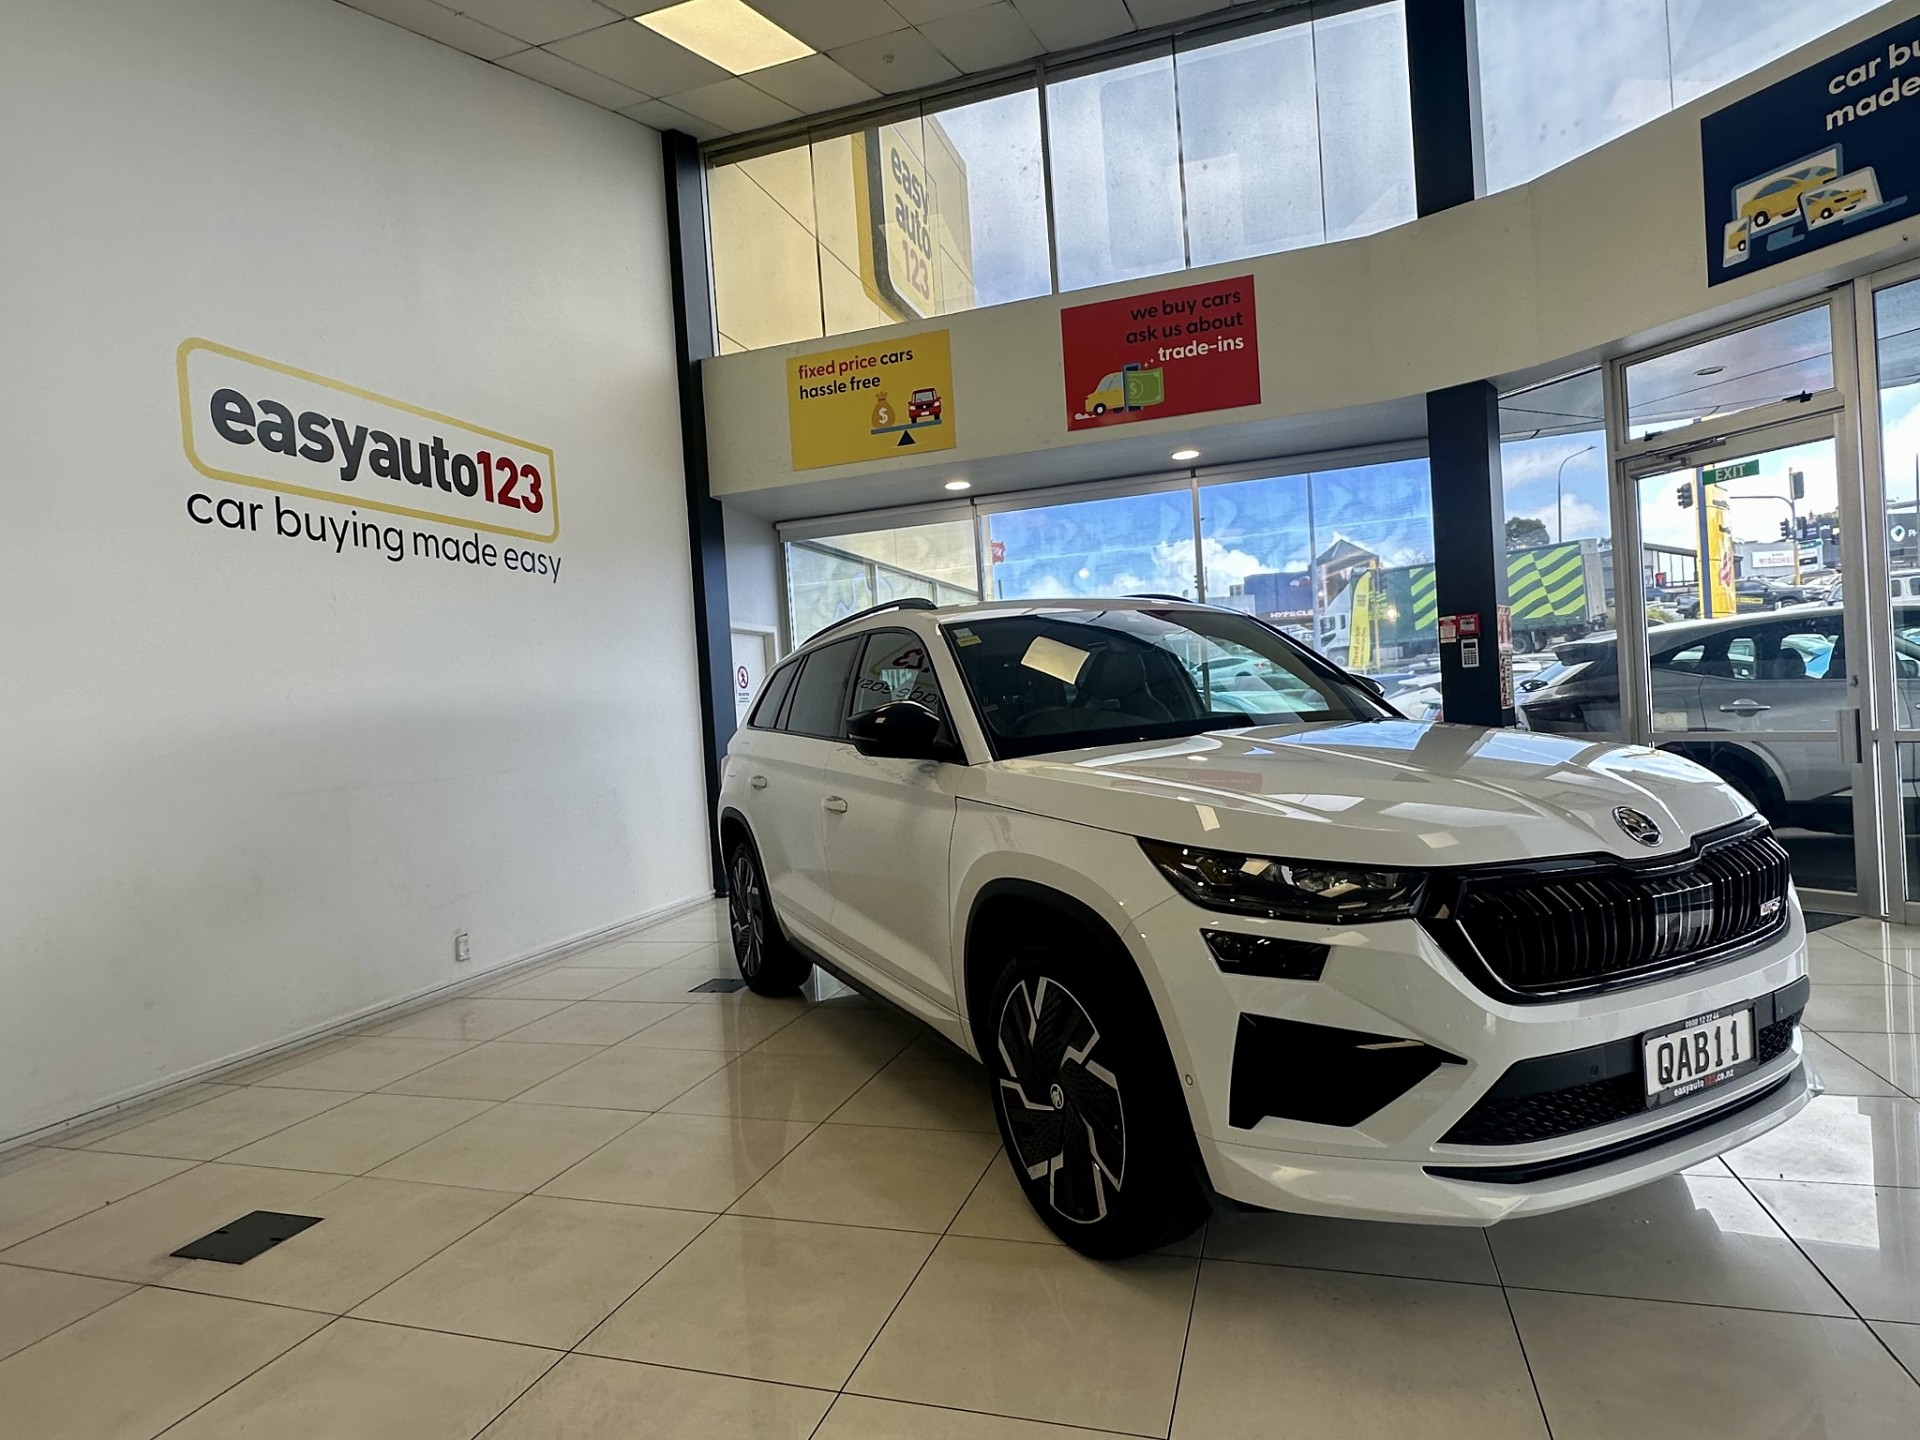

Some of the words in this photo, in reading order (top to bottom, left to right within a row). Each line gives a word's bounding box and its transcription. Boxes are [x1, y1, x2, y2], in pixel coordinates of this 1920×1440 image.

[1828, 57, 1881, 95] car
[1826, 76, 1920, 131] made
[890, 147, 929, 225] easy
[894, 193, 932, 261] auto
[902, 239, 930, 300] 123
[1126, 325, 1158, 344] ask
[1162, 323, 1182, 338] us
[1186, 312, 1243, 333] about
[1131, 305, 1158, 321] we
[1162, 299, 1197, 316] buy
[1201, 290, 1241, 309] cars
[798, 360, 836, 380] fixed
[838, 355, 877, 377] price
[880, 349, 913, 365] cars
[1157, 335, 1245, 362] trade-ins
[799, 380, 847, 400] hassle
[850, 376, 881, 391] free
[209, 387, 544, 514] easyauto123
[1715, 464, 1746, 481] EXIT
[186, 493, 263, 531] car
[275, 496, 404, 562] buying
[412, 530, 497, 568] made
[504, 547, 562, 583] easy
[1658, 1020, 1739, 1085] QAB11
